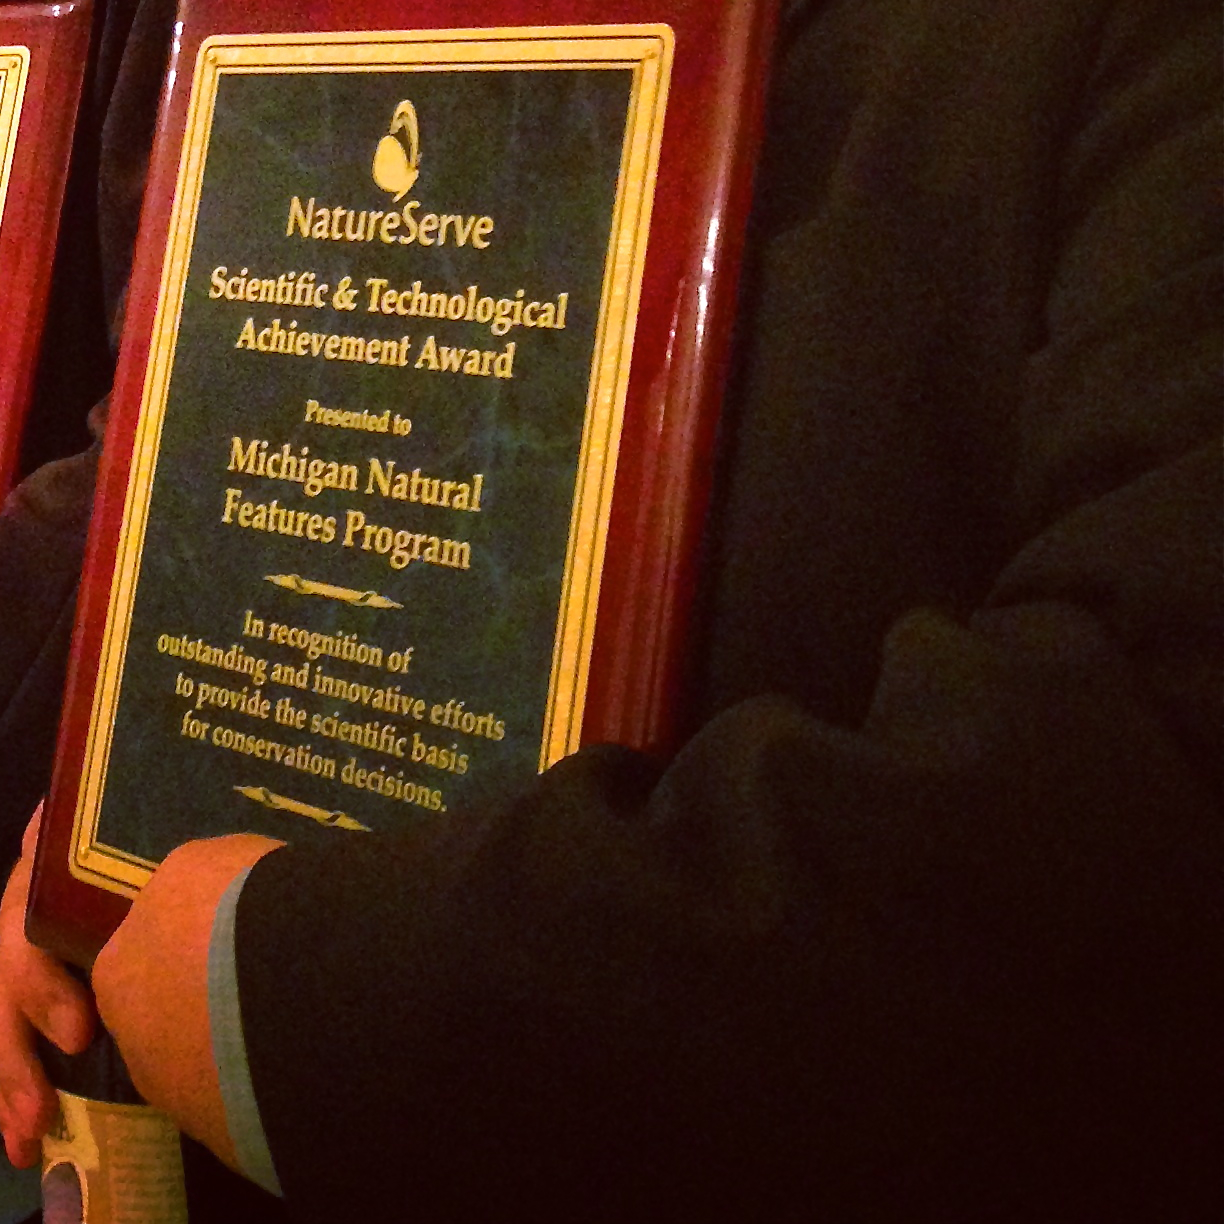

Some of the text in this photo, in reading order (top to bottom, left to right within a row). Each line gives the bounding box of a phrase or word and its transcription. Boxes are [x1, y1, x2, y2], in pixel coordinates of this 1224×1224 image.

[286, 196, 494, 249] NatureServe
[208, 266, 569, 336] Scientific & Technological
[235, 318, 516, 379] Achievement Award
[304, 399, 412, 437] Presented to
[227, 436, 483, 512] Michigan Natural
[221, 488, 471, 570] Features Program
[242, 609, 413, 674] In recognition of
[157, 632, 505, 741] outstanding and innovative efforts
[175, 672, 468, 774] to provide the scientific basis
[180, 710, 447, 812] for conservation decisions.
